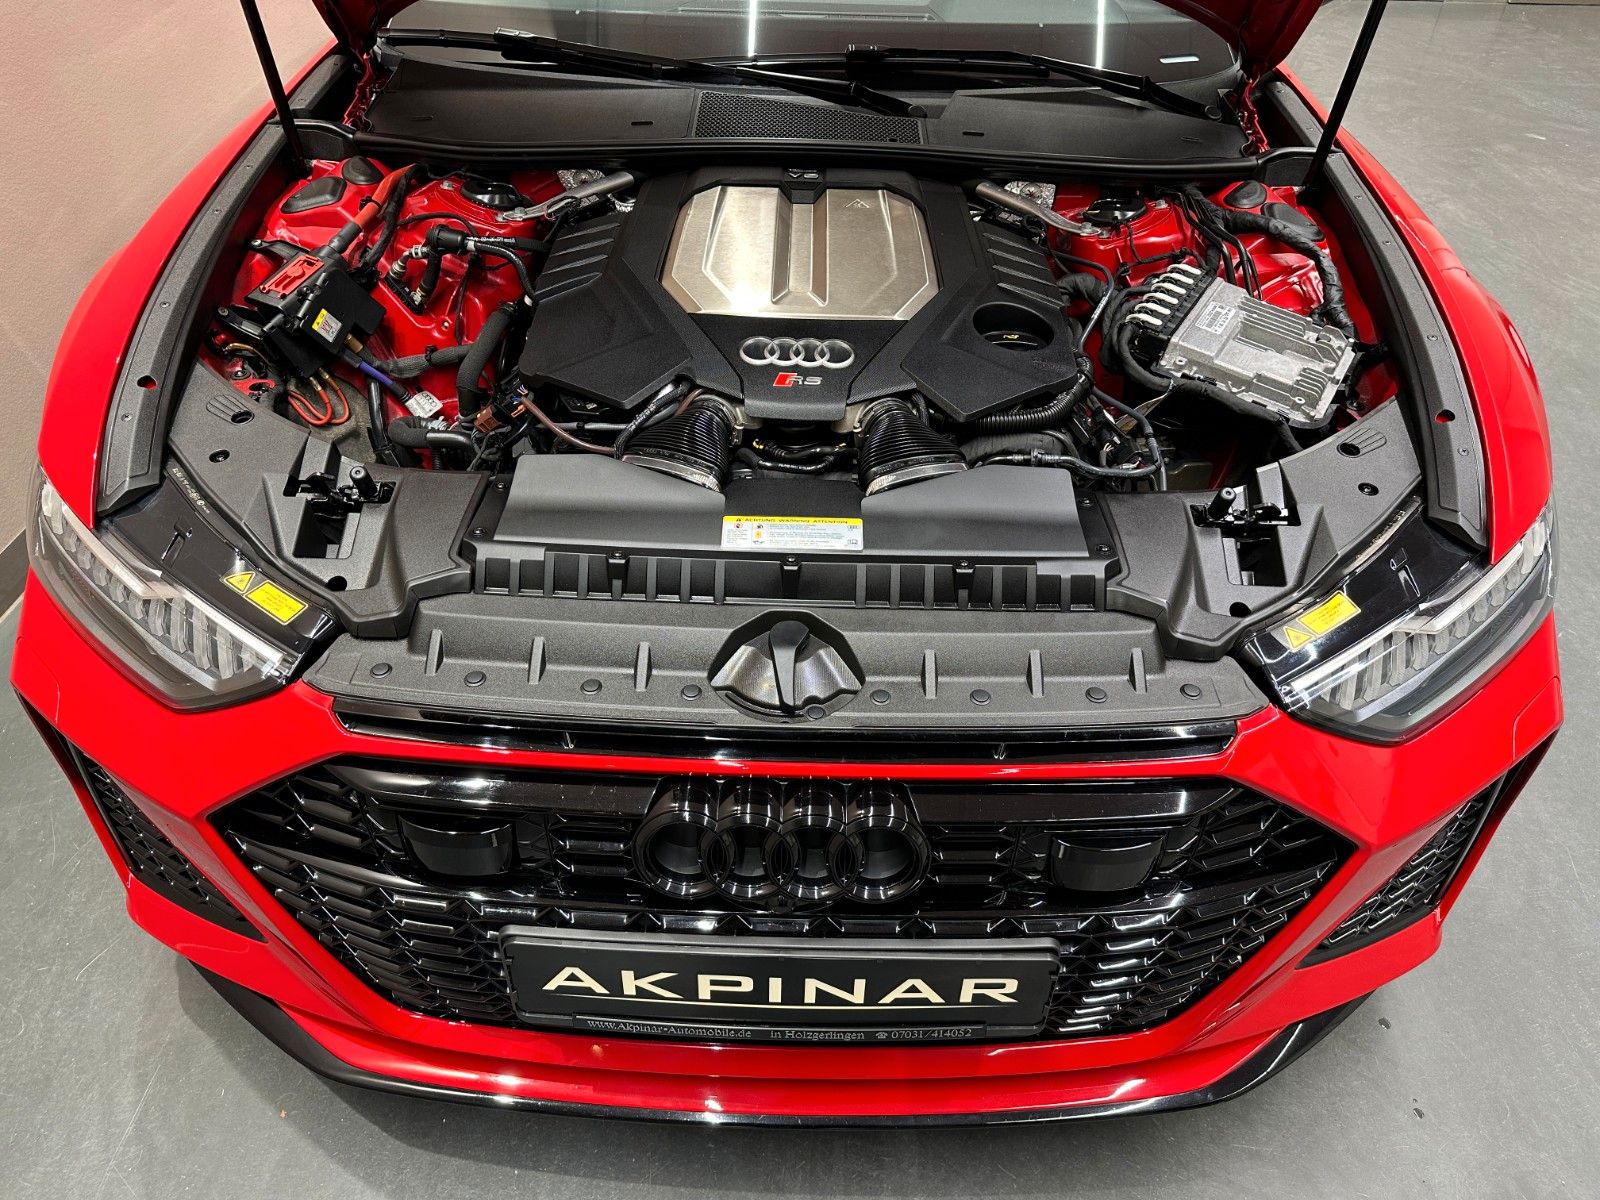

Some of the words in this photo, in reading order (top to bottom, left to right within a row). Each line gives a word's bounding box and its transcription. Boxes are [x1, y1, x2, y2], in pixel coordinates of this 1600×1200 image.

[773, 372, 823, 387] RS
[542, 966, 1019, 1004] AKPINAR
[586, 1020, 752, 1038] www.Akpinar-Automobile.de
[770, 1029, 782, 1039] in
[784, 1030, 865, 1041] Holzgerlingen
[891, 1028, 973, 1040] 07031/414052
